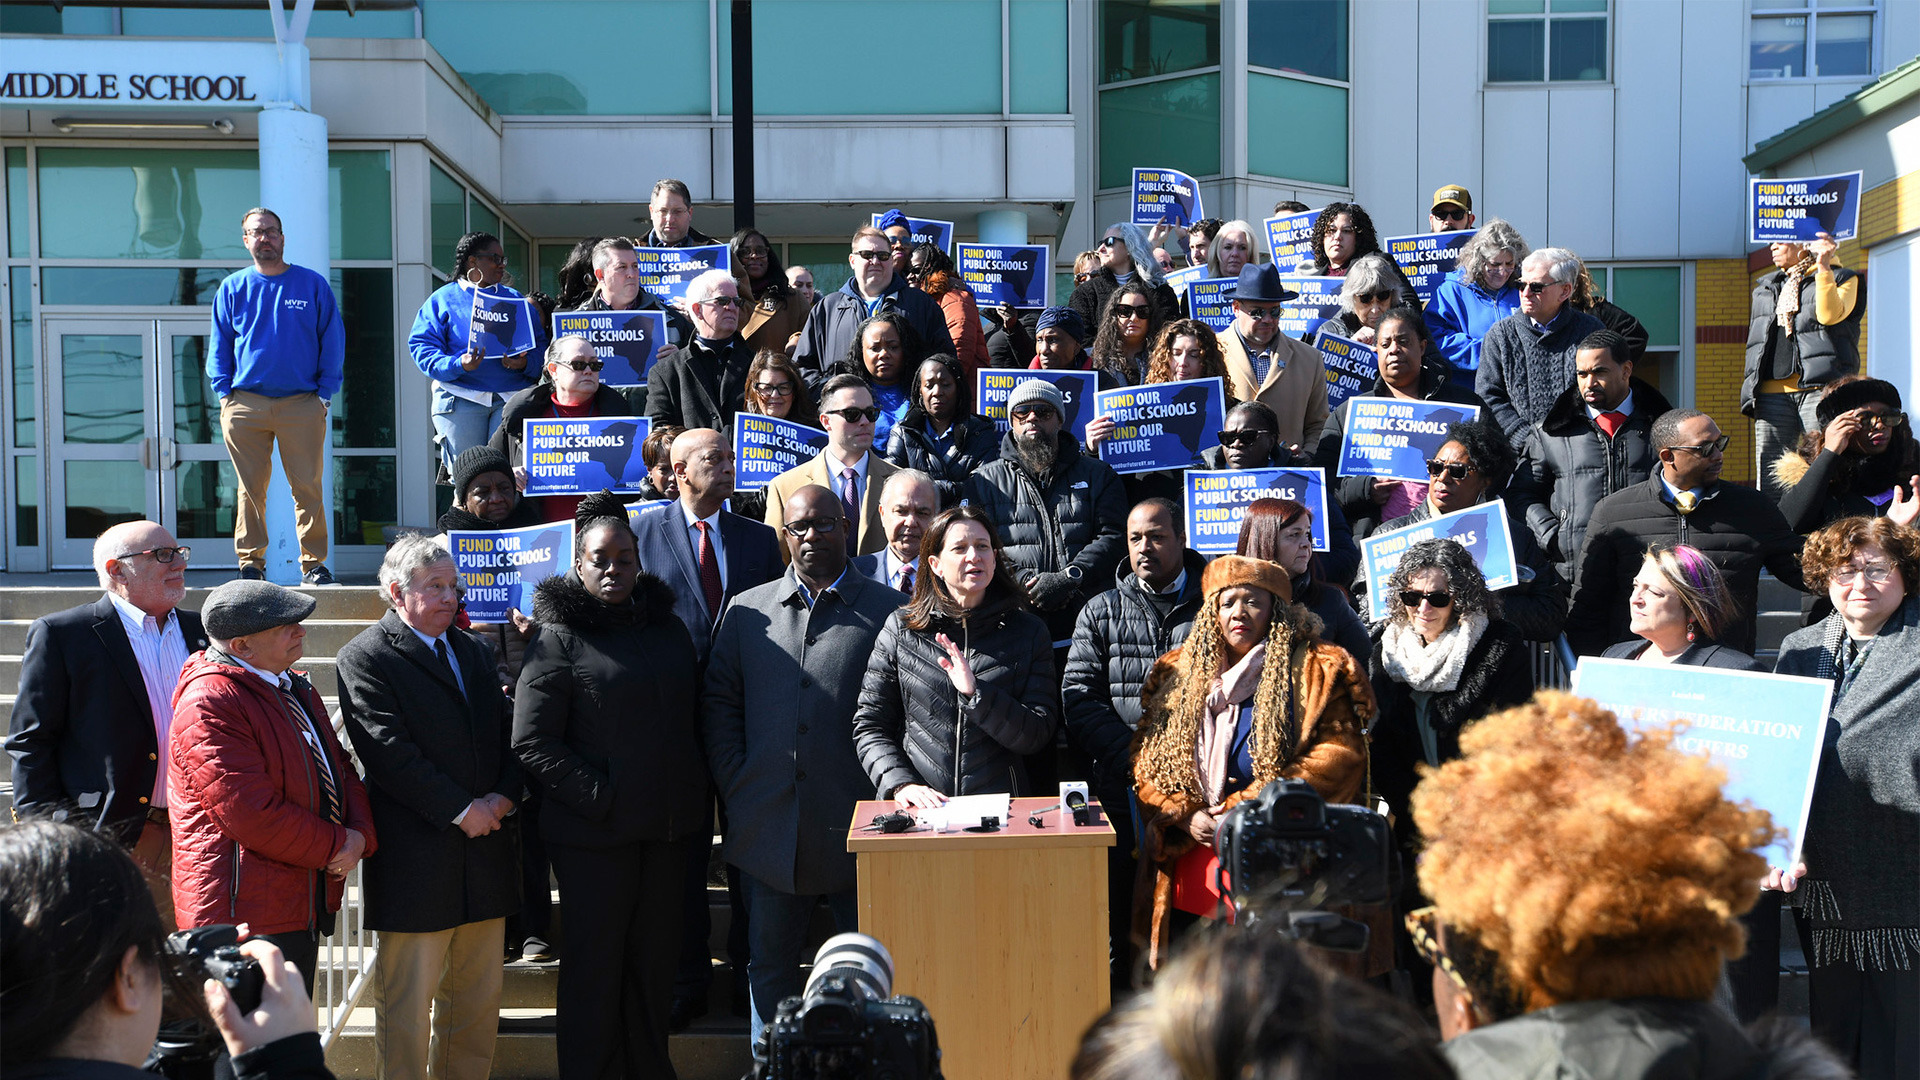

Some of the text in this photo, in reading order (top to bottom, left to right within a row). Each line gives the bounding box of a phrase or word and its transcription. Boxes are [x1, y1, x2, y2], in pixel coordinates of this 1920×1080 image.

[129, 75, 256, 100] SCHOOL
[1139, 173, 1175, 183] FUND OUR
[1139, 183, 1191, 197] PUBLIC SCHOOLS
[1759, 184, 1807, 194] FUND OUR
[1138, 194, 1175, 203] FUND OUR
[1759, 192, 1838, 206] PUBLIC SCHOOLS
[1138, 204, 1166, 212] FUTURE
[1759, 208, 1806, 218] FUND OUR
[1271, 217, 1309, 233] FUND OUR
[1759, 219, 1794, 229] FUTURE
[1272, 230, 1299, 244] PUBLIC
[1275, 245, 1295, 256] FUND
[1392, 239, 1437, 252] FUND OUR
[661, 253, 680, 262] OUR
[964, 249, 1002, 259] FUND OUR
[669, 260, 708, 272] SCHOOLS
[964, 259, 1028, 270] PUBLIC SCHOOLS
[1419, 264, 1438, 274] OUR
[662, 275, 681, 284] OUR
[964, 272, 1002, 283] FUND OUR
[1195, 284, 1218, 294] FUND
[1302, 282, 1322, 293] OUR
[477, 309, 509, 322] SCHOOLS
[1197, 307, 1220, 316] FUND
[1300, 308, 1319, 320] OUR
[561, 318, 613, 330] FUND OUR
[600, 330, 644, 342] SCHOOLS
[1322, 339, 1372, 364] FUND OUR
[986, 376, 1014, 388] FUND
[1339, 375, 1361, 391] OUR
[1104, 391, 1160, 410] FUND OUR
[1147, 402, 1196, 419] SCHOOLS
[1356, 404, 1414, 418] FUND OUR
[533, 424, 590, 436] FUND OUR
[744, 419, 797, 440] FUND OUR
[1140, 423, 1163, 437] OUR
[1354, 417, 1448, 435] PUBLIC SCHOOLS
[533, 436, 624, 449] PUBLIC SCHOOLS
[743, 432, 782, 447] PUBLIC
[1352, 434, 1408, 448] FUND OUR
[1108, 439, 1151, 455] FUTURE
[1349, 447, 1392, 460] FUTURE
[532, 452, 589, 464] FUND OUR
[743, 447, 797, 466] FUND OUR
[532, 465, 575, 477] FUTURE
[742, 460, 784, 474] FUTURE
[1195, 476, 1256, 491] FUND OUR
[1195, 488, 1295, 505] PUBLIC SCHOOLS
[1196, 508, 1230, 521] FUND
[459, 537, 521, 552] FUND OUR
[1372, 537, 1407, 558] FUND
[460, 547, 551, 568] PUBLIC SCHOOLS
[497, 571, 521, 586] OUR
